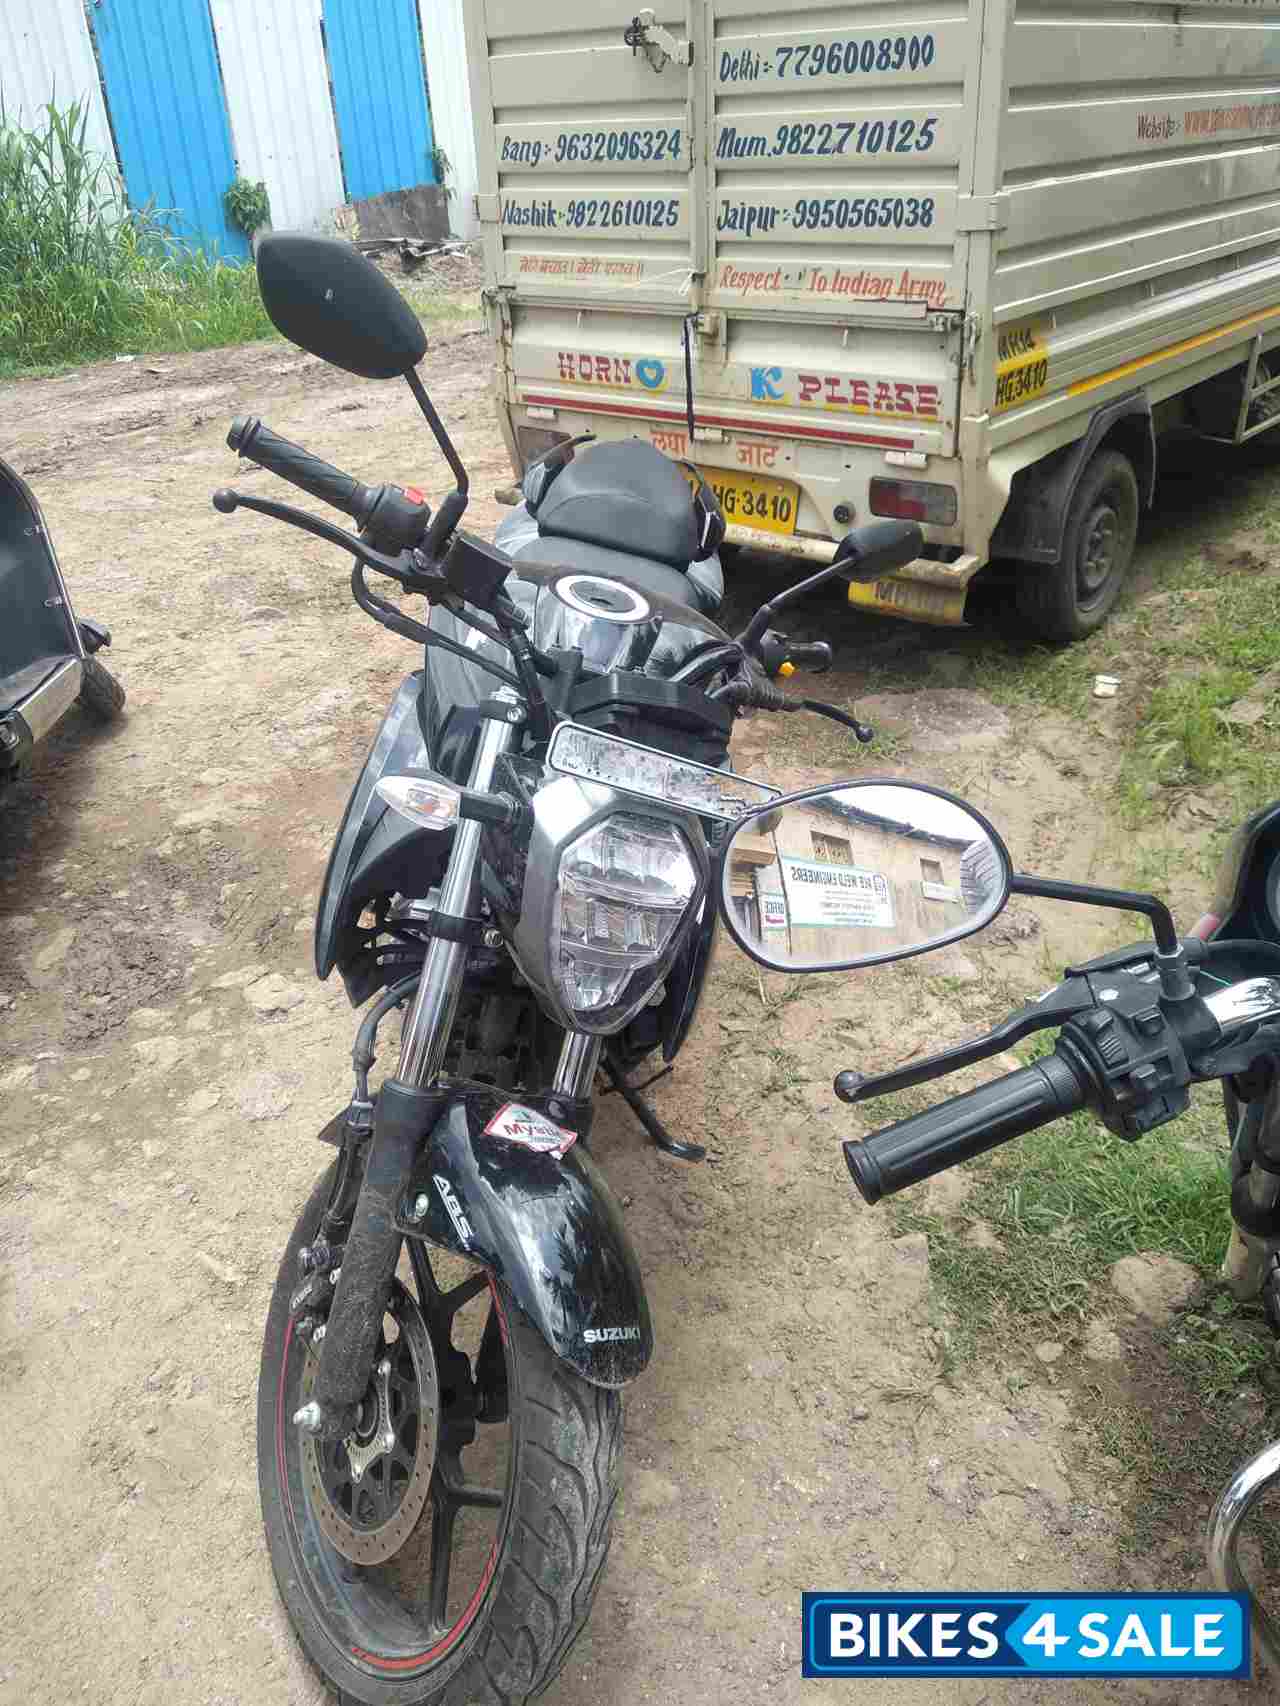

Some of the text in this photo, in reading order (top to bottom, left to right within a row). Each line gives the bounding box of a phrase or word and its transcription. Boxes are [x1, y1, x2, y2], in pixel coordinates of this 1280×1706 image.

[775, 34, 934, 78] 7796008900
[555, 129, 681, 161] 9632096324
[772, 118, 938, 156] 9822710125
[566, 199, 679, 228] 9822610125
[792, 198, 935, 229] 9950565038
[810, 267, 829, 292] To
[831, 268, 894, 298] Indian
[899, 269, 947, 307] Army
[558, 352, 631, 384] HORN
[798, 374, 938, 416] PLEASE
[583, 1327, 640, 1343] SUZUKI
